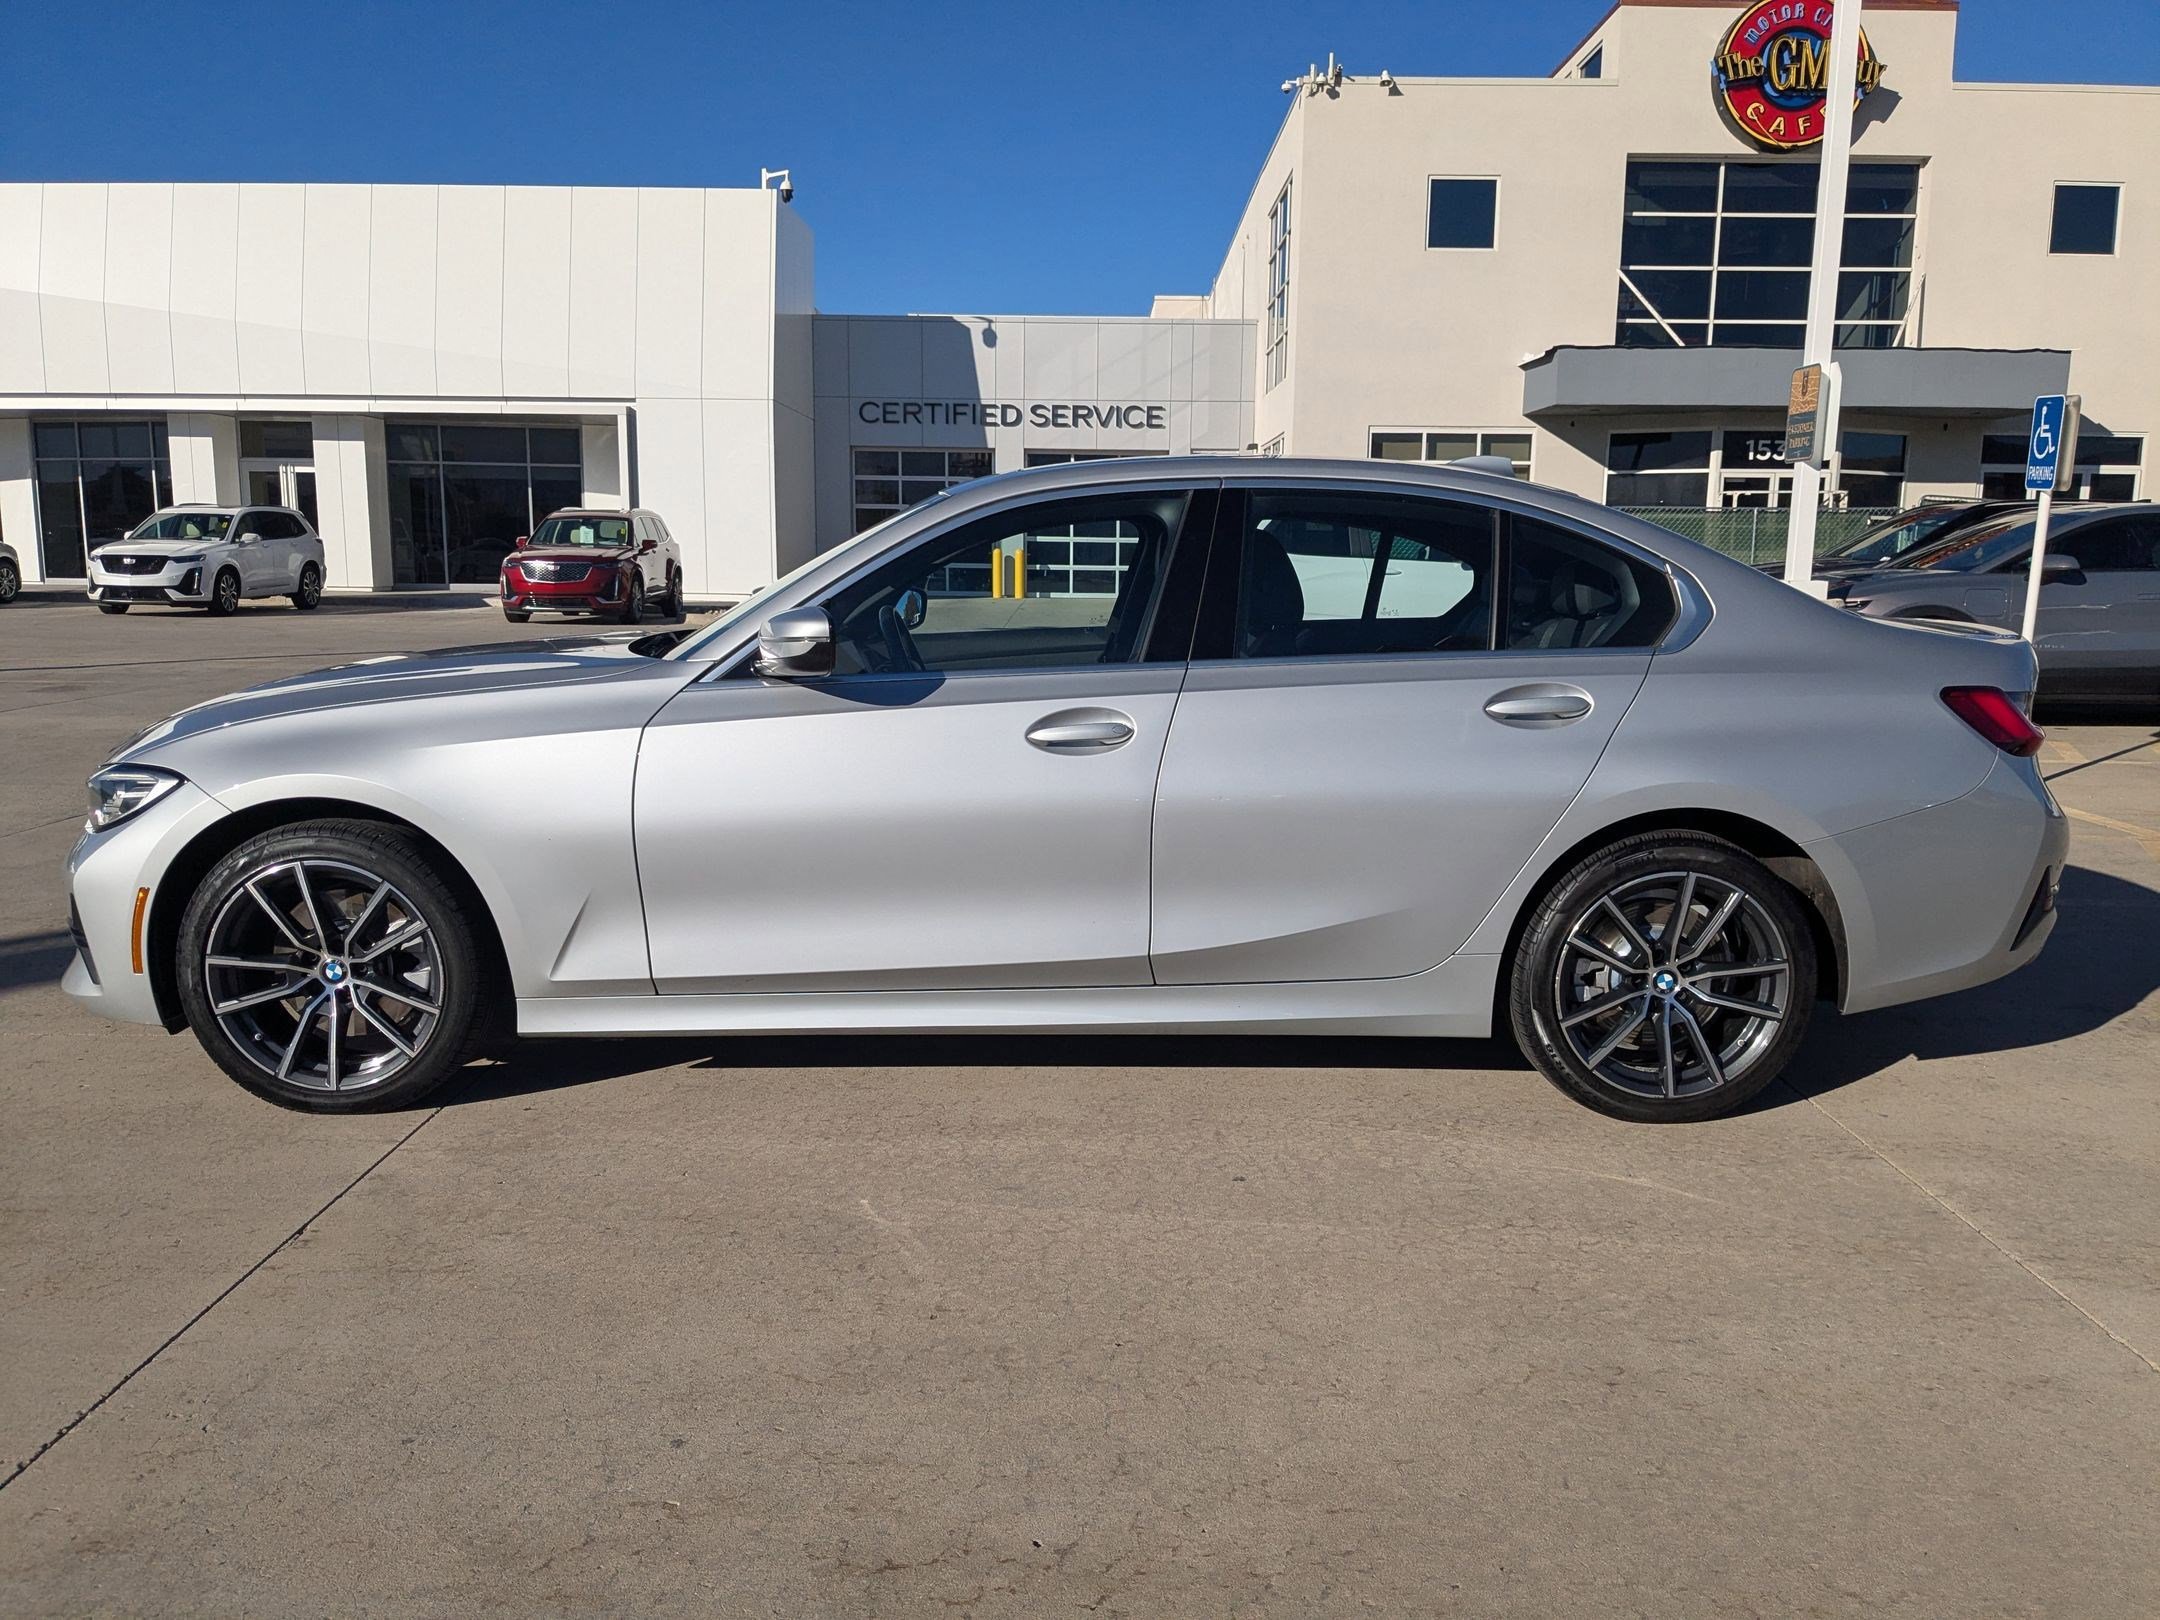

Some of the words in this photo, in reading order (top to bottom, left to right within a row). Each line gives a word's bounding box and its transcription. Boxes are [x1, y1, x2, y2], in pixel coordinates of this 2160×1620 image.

[1744, 3, 1804, 43] MOTOR
[1718, 51, 1765, 81] The
[1770, 35, 1830, 91] GM
[1858, 59, 1888, 94] uy
[858, 401, 1023, 427] CERTIFIED
[1029, 404, 1166, 430] SERVICE
[2028, 465, 2054, 481] PARKING
